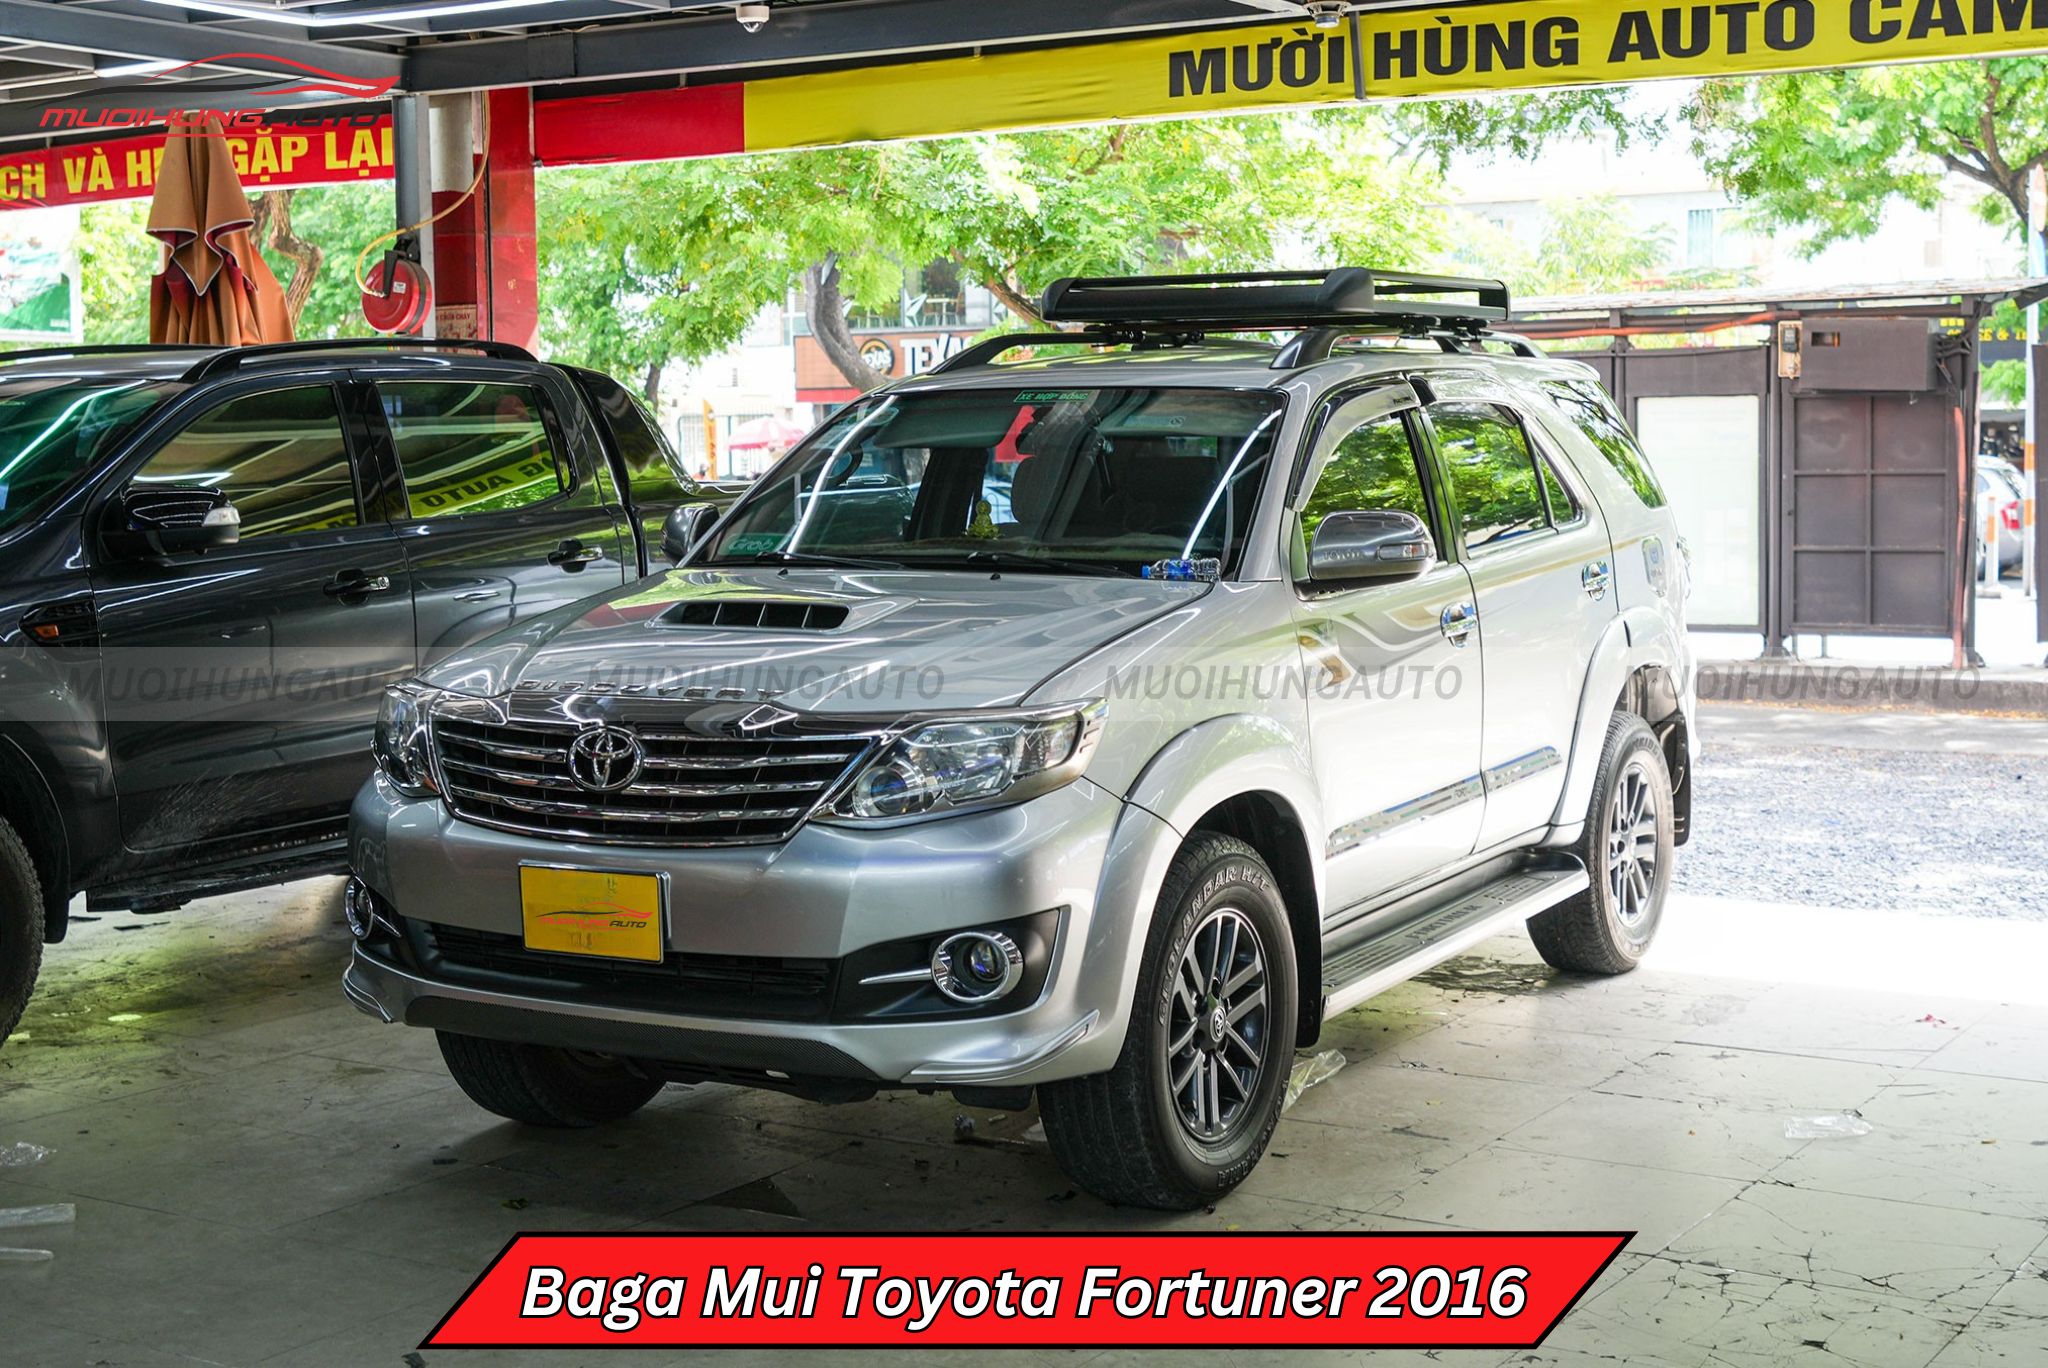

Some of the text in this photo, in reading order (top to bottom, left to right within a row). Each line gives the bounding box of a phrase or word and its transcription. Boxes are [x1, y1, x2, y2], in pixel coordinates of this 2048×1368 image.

[1169, 28, 1346, 98] MƯỜI
[1374, 16, 1580, 81] HÙNG
[1607, 0, 1815, 63] AUTO
[63, 147, 115, 194] VÀ
[225, 127, 308, 182] GẶP
[325, 127, 394, 176] LẠI
[900, 333, 973, 377] TEXA
[515, 679, 785, 701] DISCOVERY
